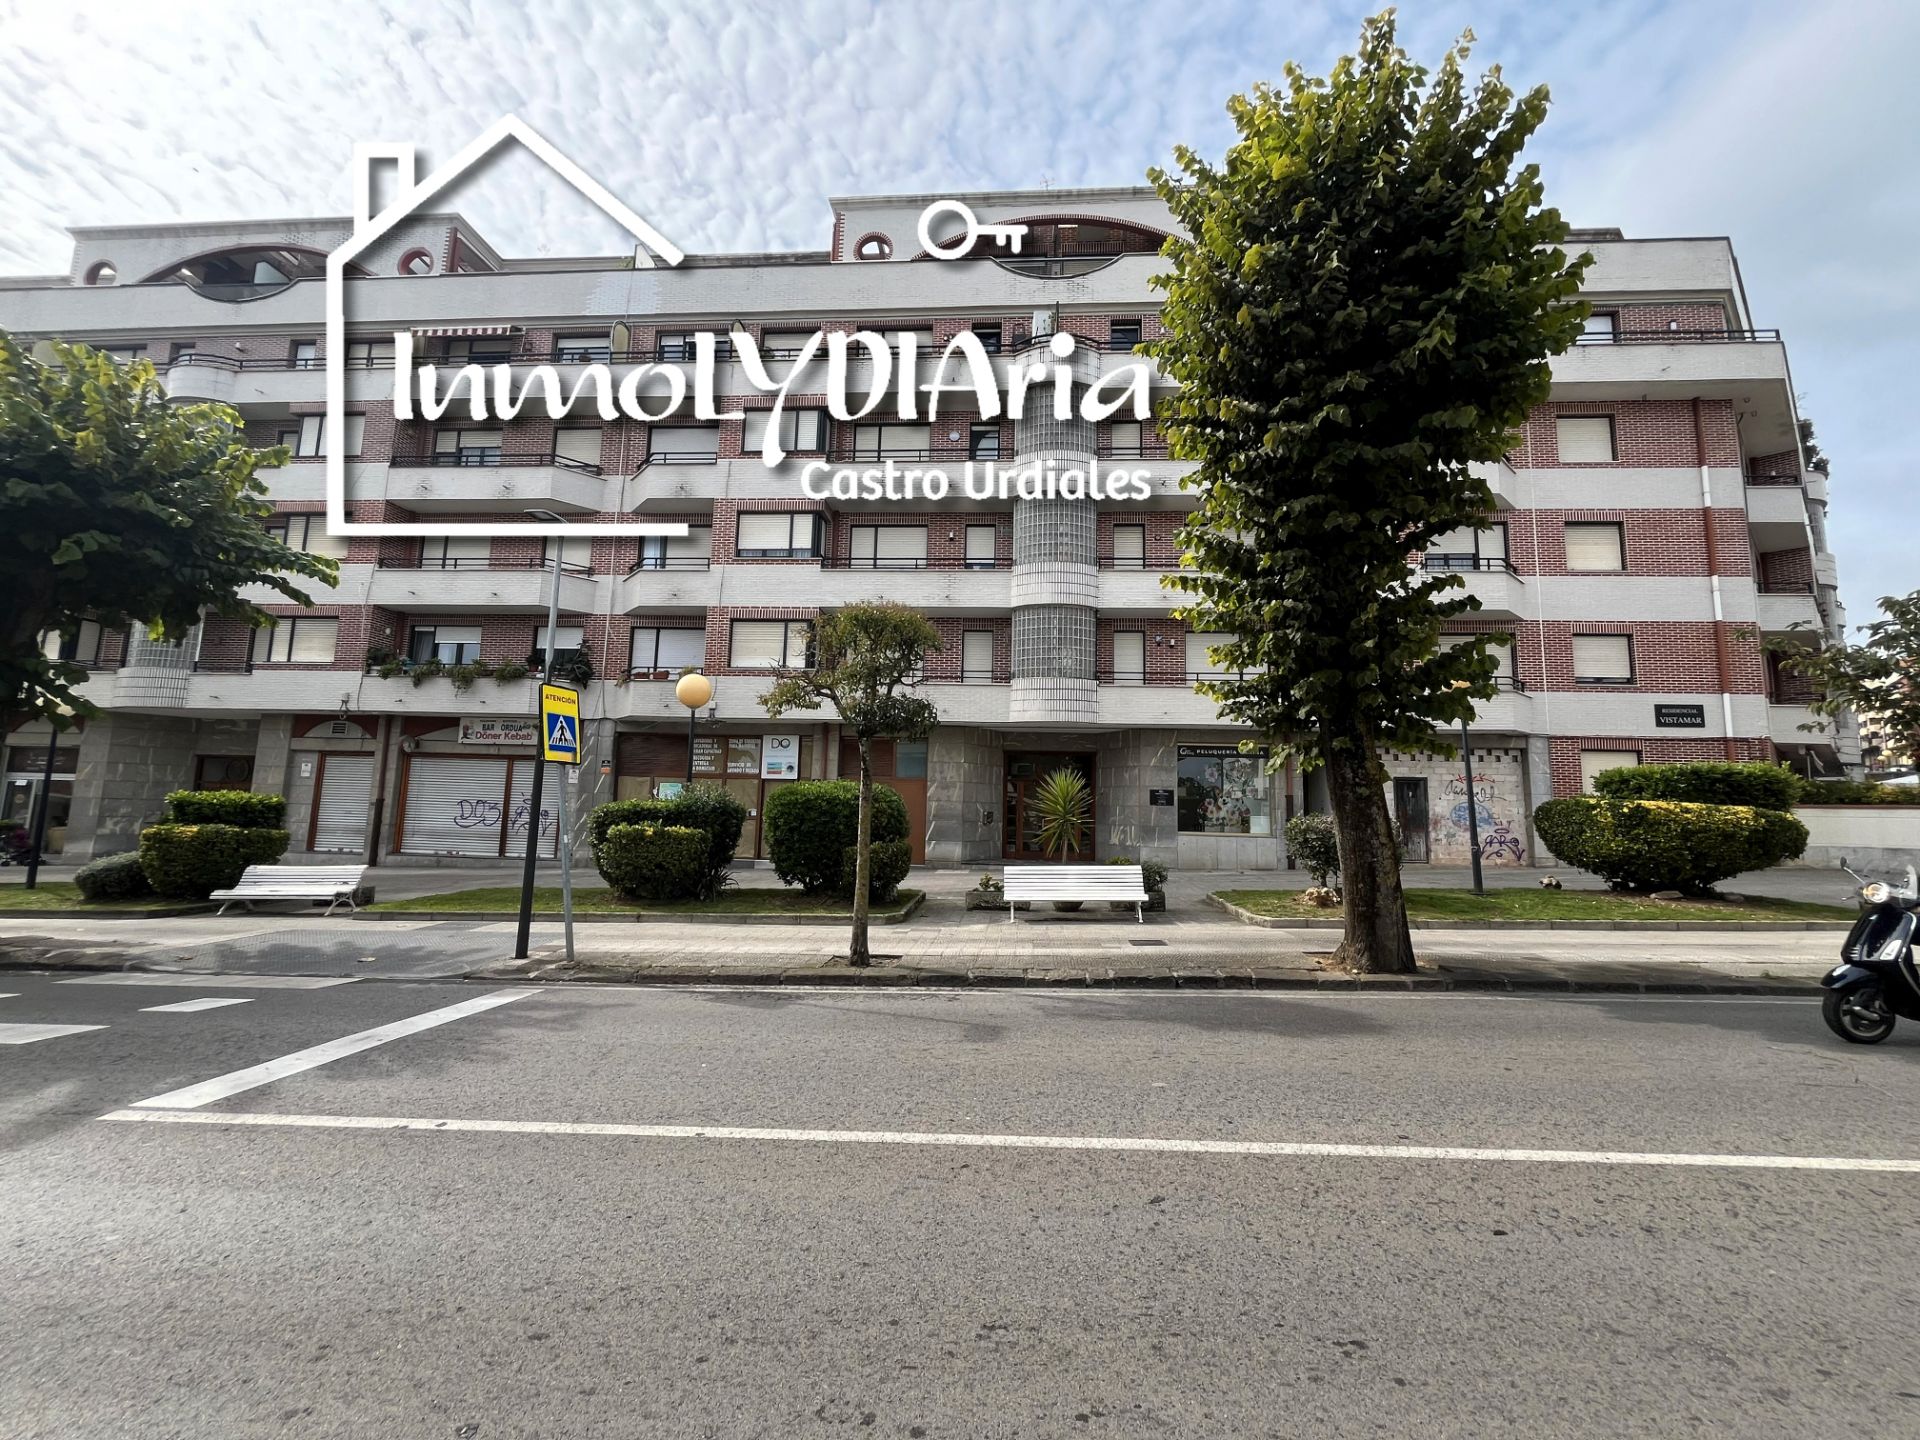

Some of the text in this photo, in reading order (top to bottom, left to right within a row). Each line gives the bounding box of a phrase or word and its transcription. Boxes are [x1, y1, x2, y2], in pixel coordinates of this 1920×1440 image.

[545, 693, 576, 705] ATENCIÓN
[1659, 716, 1702, 724] VISTAMAR
[482, 723, 495, 731] BAR
[475, 731, 533, 741] Döner Kebab
[771, 738, 791, 749] DO
